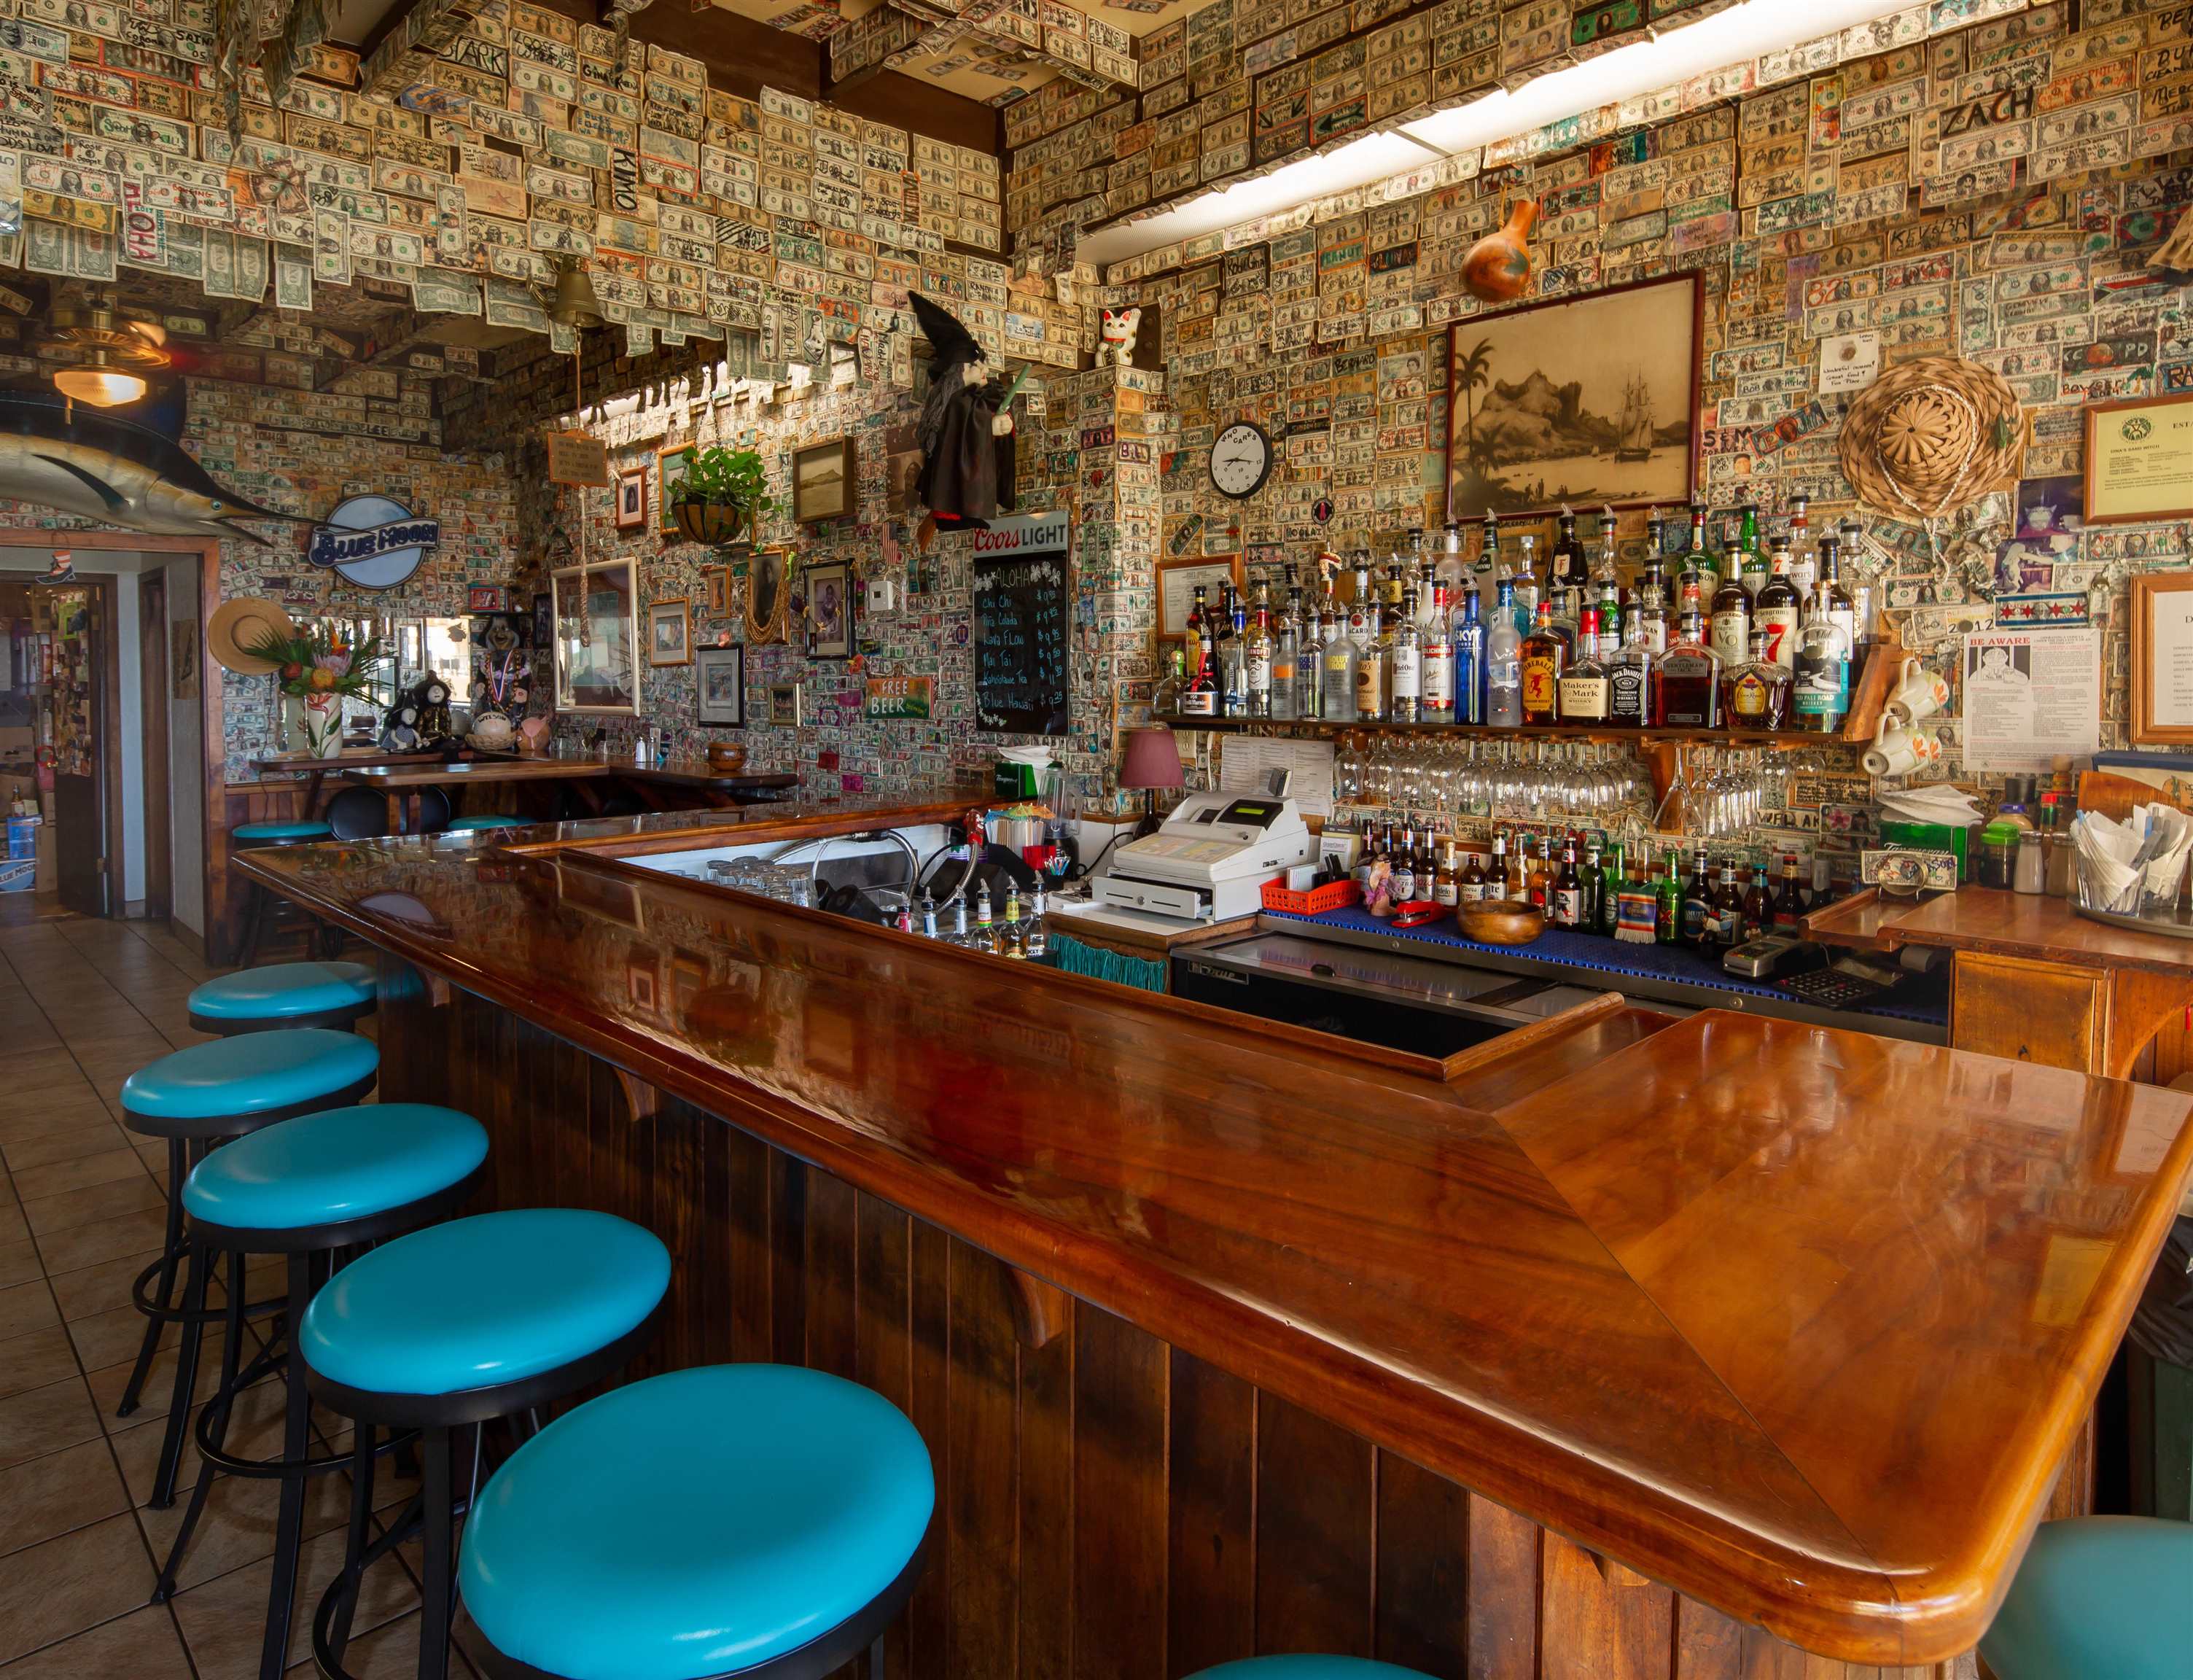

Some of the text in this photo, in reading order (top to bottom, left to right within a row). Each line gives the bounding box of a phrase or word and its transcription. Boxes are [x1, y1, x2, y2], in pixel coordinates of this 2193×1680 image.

[1944, 85, 2033, 136] ZACH
[613, 147, 639, 211] KIMO
[745, 228, 770, 243] NATE
[1220, 428, 1238, 443] WHO
[1233, 430, 1258, 445] CARES
[1702, 446, 1748, 457] FOREVER
[312, 524, 437, 566] BLUE MOON
[974, 524, 1066, 552] Coors LIGHT
[996, 567, 1030, 588] ALOHA
[1454, 629, 1482, 642] SKYY
[1970, 637, 1984, 645] BE
[1988, 637, 2030, 645] AWARE
[1764, 623, 1791, 664] 7
[881, 680, 908, 695] FREE
[1562, 682, 1600, 690] Maker's
[871, 696, 905, 715] BEER
[983, 691, 1004, 708] Blue
[478, 713, 507, 723] WILSON
